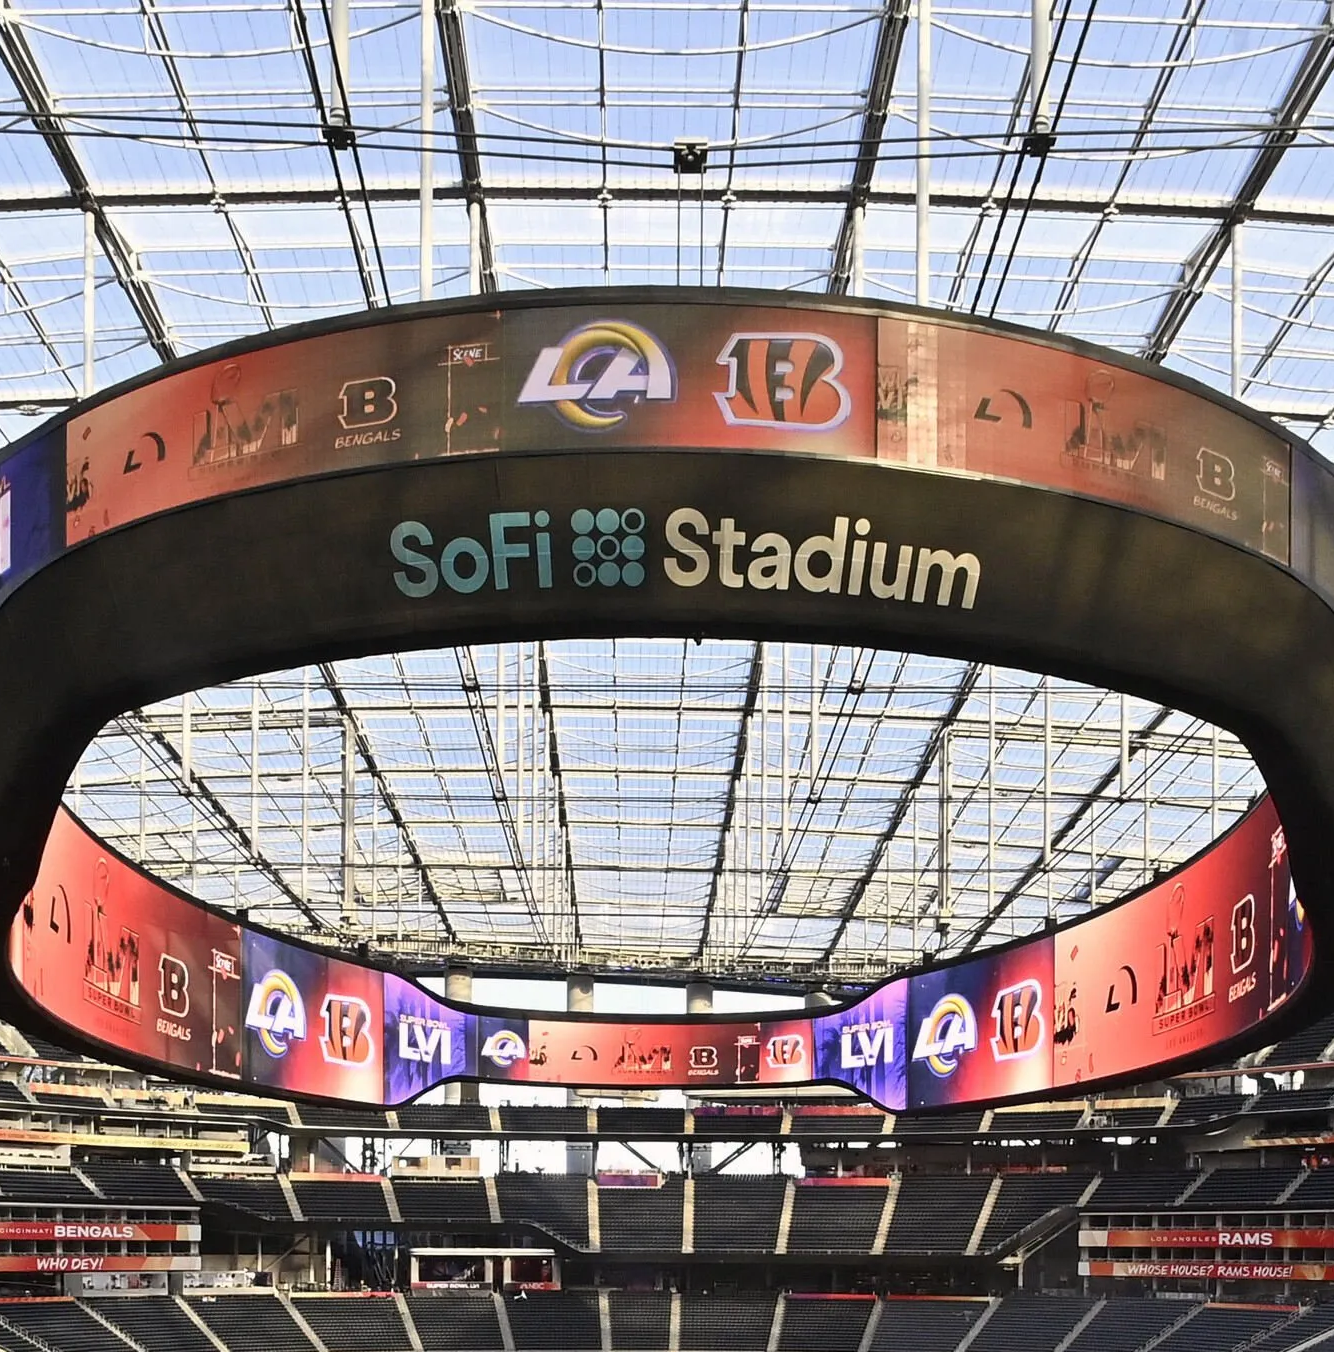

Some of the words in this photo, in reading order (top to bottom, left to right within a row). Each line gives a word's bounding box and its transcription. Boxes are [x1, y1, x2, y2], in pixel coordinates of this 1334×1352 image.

[334, 427, 402, 449] BENGALS
[1193, 495, 1238, 521] BENGALS
[389, 510, 553, 598] SoFi
[663, 507, 981, 609] Stadium
[1229, 972, 1257, 1003] BENGALS
[399, 1013, 426, 1026] SUPER
[1159, 1010, 1187, 1029] SUPER
[1188, 1003, 1211, 1020] BOWL
[156, 1018, 192, 1041] BENGALS
[841, 1022, 870, 1034] SUPER
[398, 1023, 451, 1064] LVI
[841, 1025, 894, 1069] LVI
[54, 1225, 134, 1238] BENGALS
[1219, 1232, 1273, 1246] RAMS
[36, 1258, 69, 1270] WHO
[71, 1257, 104, 1270] DEY!
[1128, 1265, 1168, 1276] WHOSE
[1170, 1265, 1215, 1277] HOUSE?
[1217, 1266, 1250, 1277] RAMS
[1252, 1265, 1294, 1277] HOUSE!
